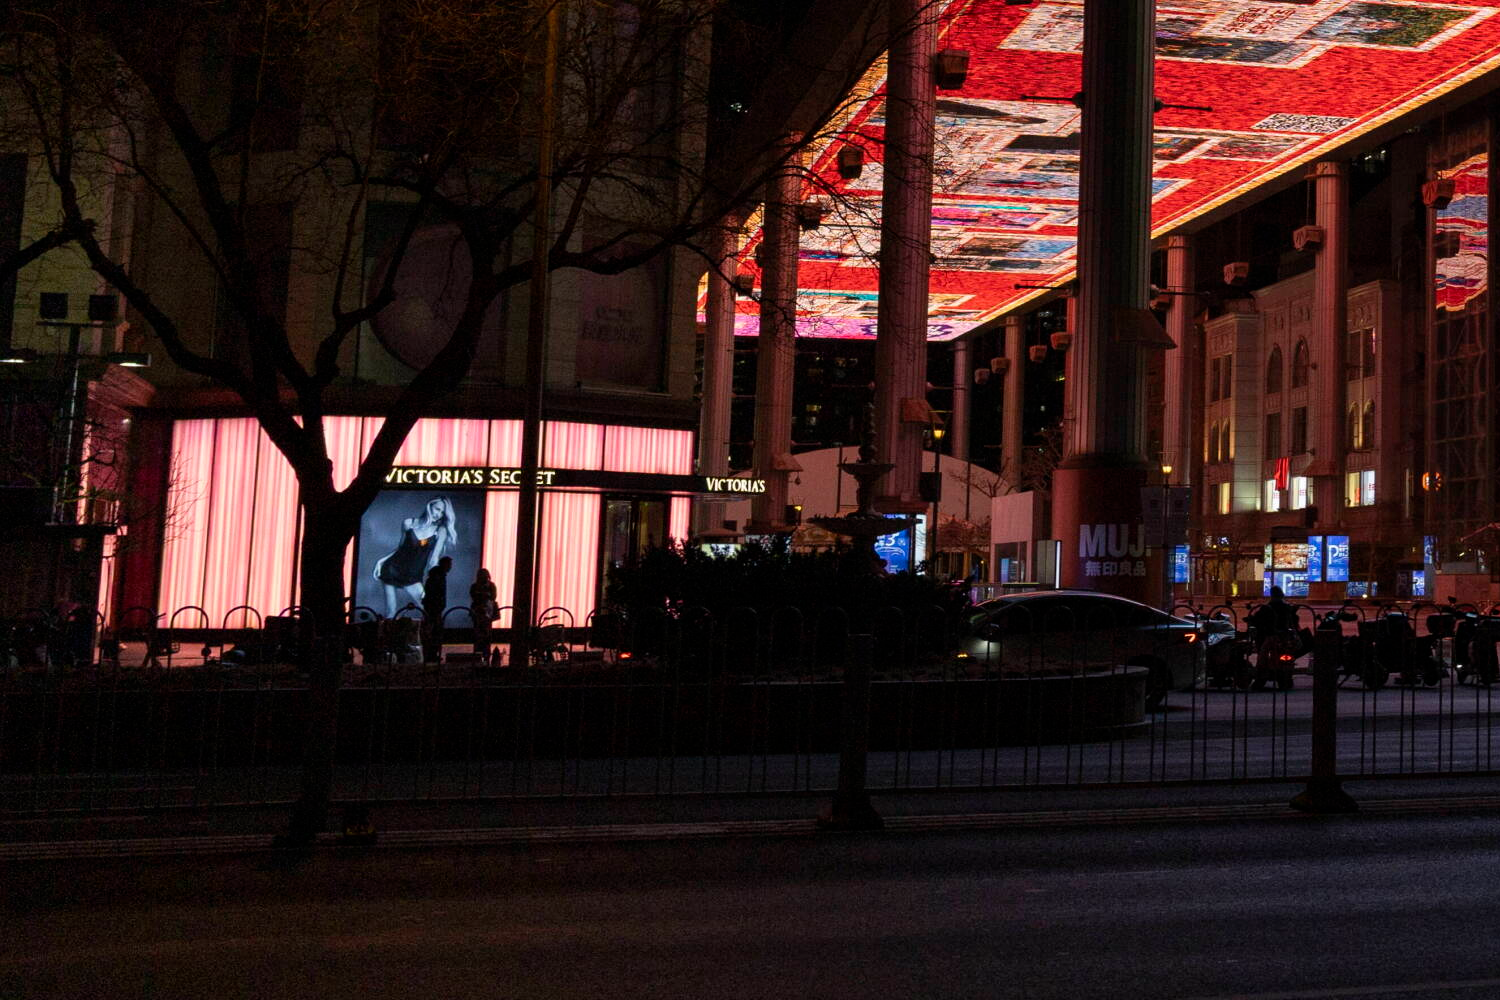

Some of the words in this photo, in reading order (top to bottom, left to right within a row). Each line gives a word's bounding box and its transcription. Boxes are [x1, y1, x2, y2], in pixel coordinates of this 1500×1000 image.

[489, 468, 556, 485] SECET
[706, 477, 766, 493] VICTORIA'S
[1079, 524, 1152, 558] MUJ
[1085, 560, 1146, 577] 無印良品
